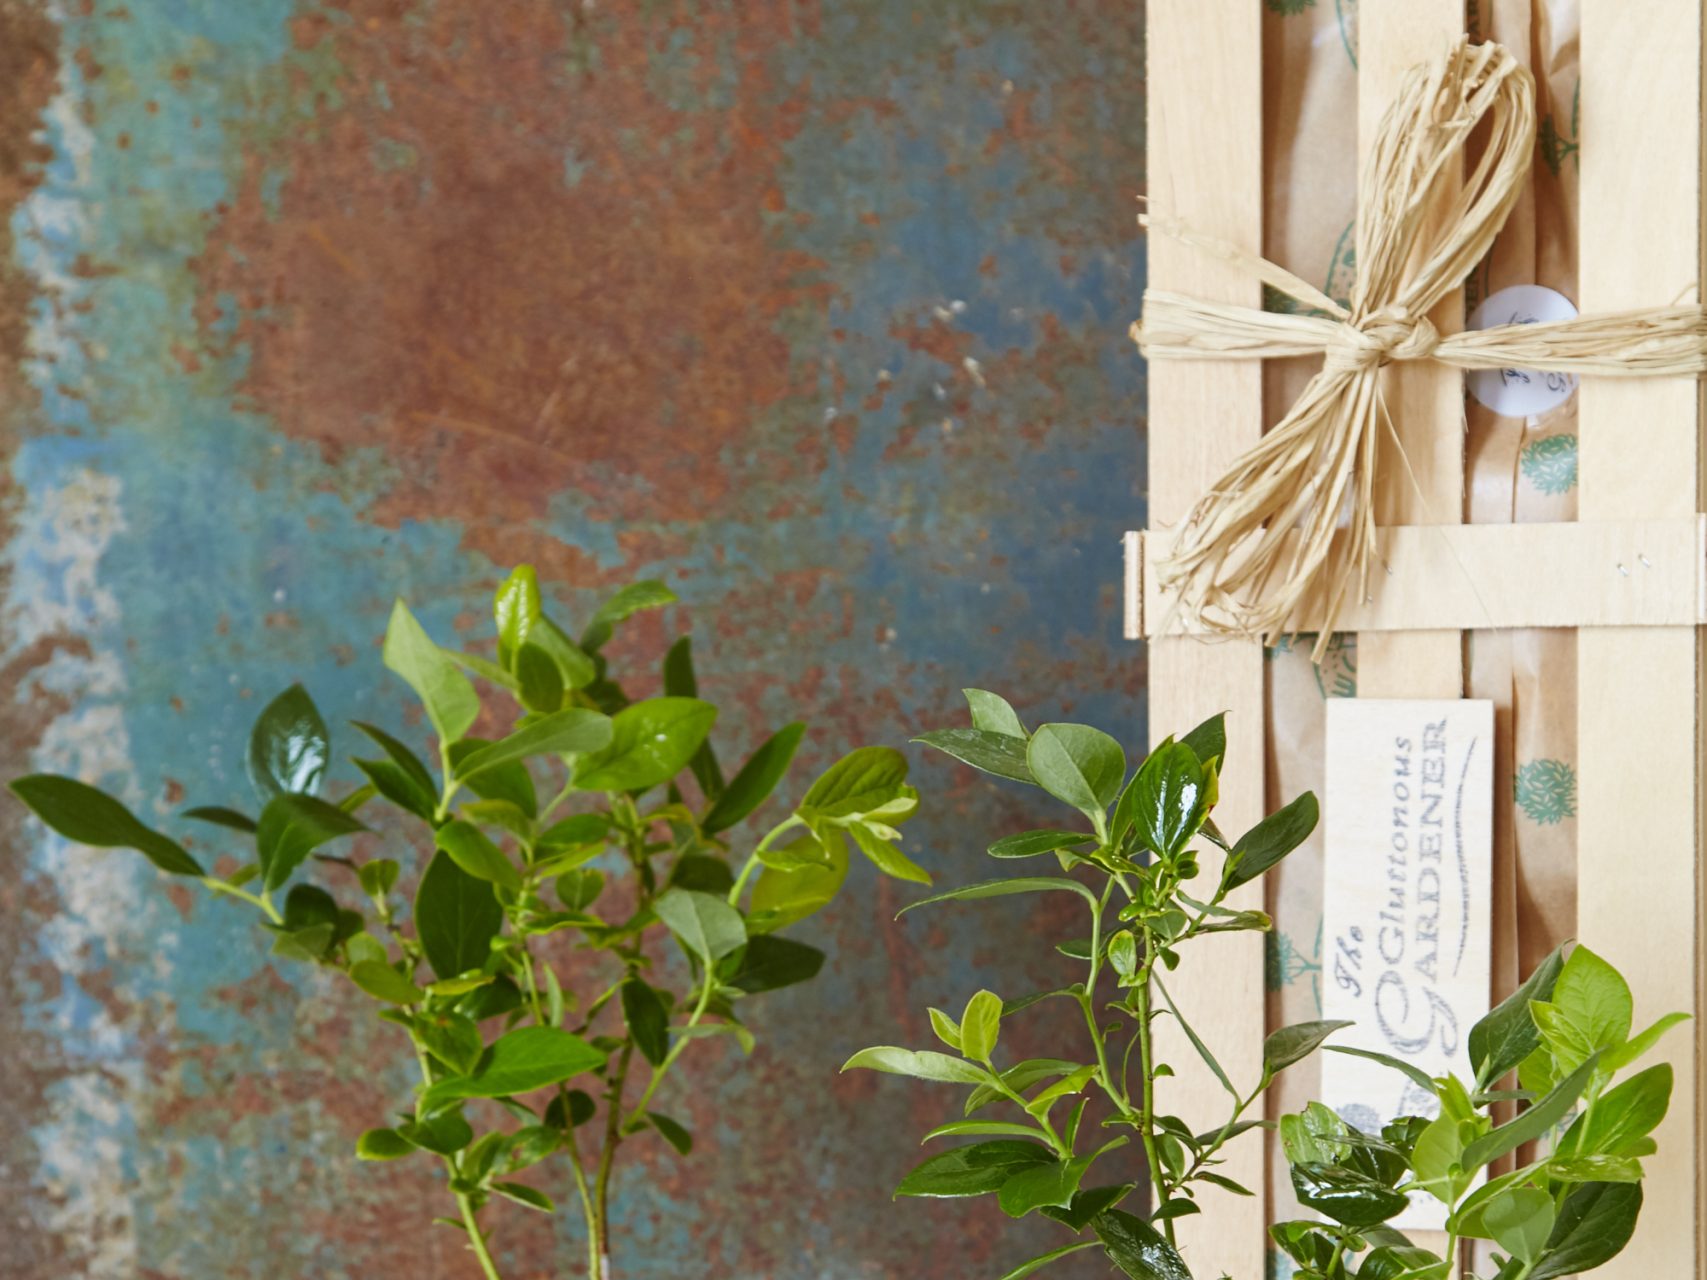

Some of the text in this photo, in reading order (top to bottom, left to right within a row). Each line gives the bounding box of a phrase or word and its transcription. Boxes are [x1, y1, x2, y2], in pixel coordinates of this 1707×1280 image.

[1334, 925, 1364, 999] The
[1374, 716, 1459, 1059] GARDENER
[1376, 735, 1414, 966] Gluttonous
